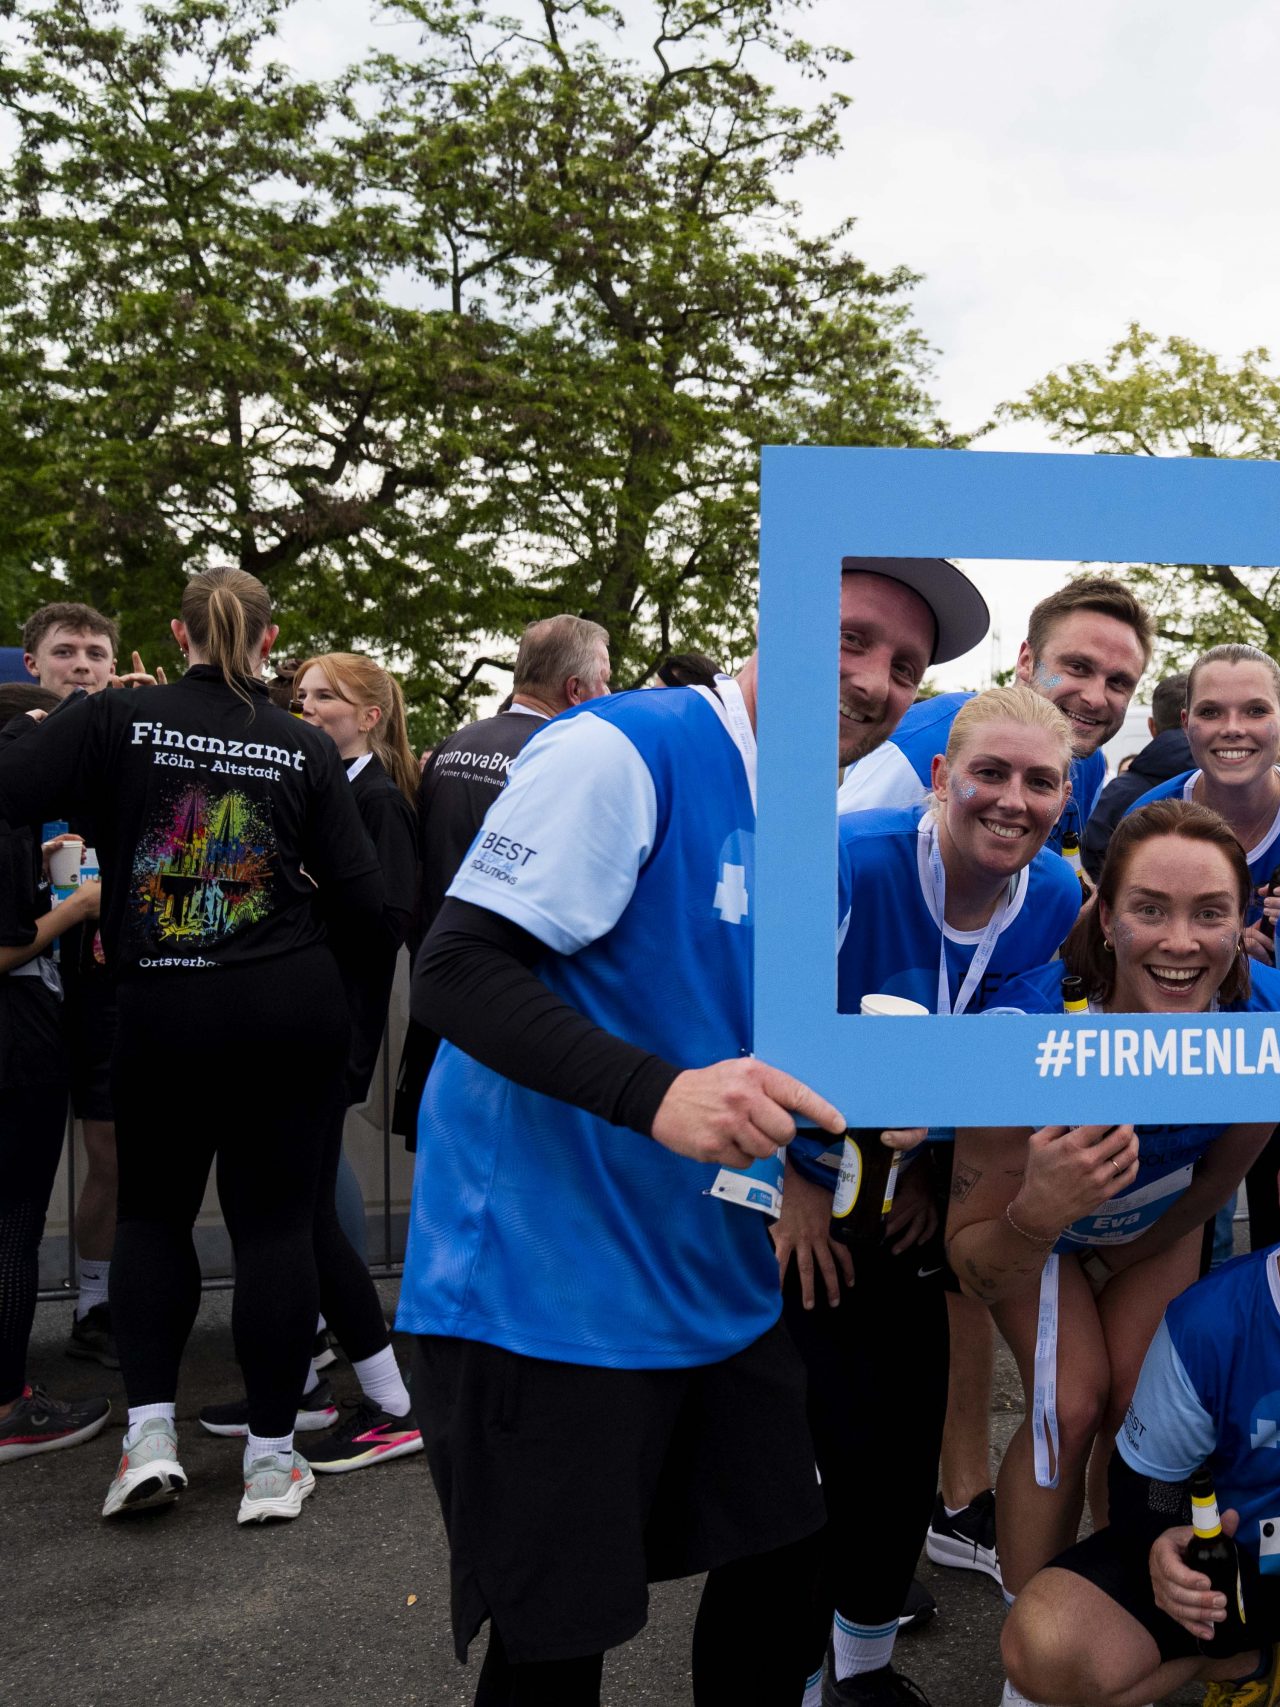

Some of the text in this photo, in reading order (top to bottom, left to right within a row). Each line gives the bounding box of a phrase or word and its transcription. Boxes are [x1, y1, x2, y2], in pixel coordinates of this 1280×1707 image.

[131, 722, 306, 771] Finanzamt
[153, 752, 195, 769] Köln
[211, 760, 281, 782] Altstadt
[482, 832, 538, 866] BEST
[1093, 1212, 1141, 1230] Eva
